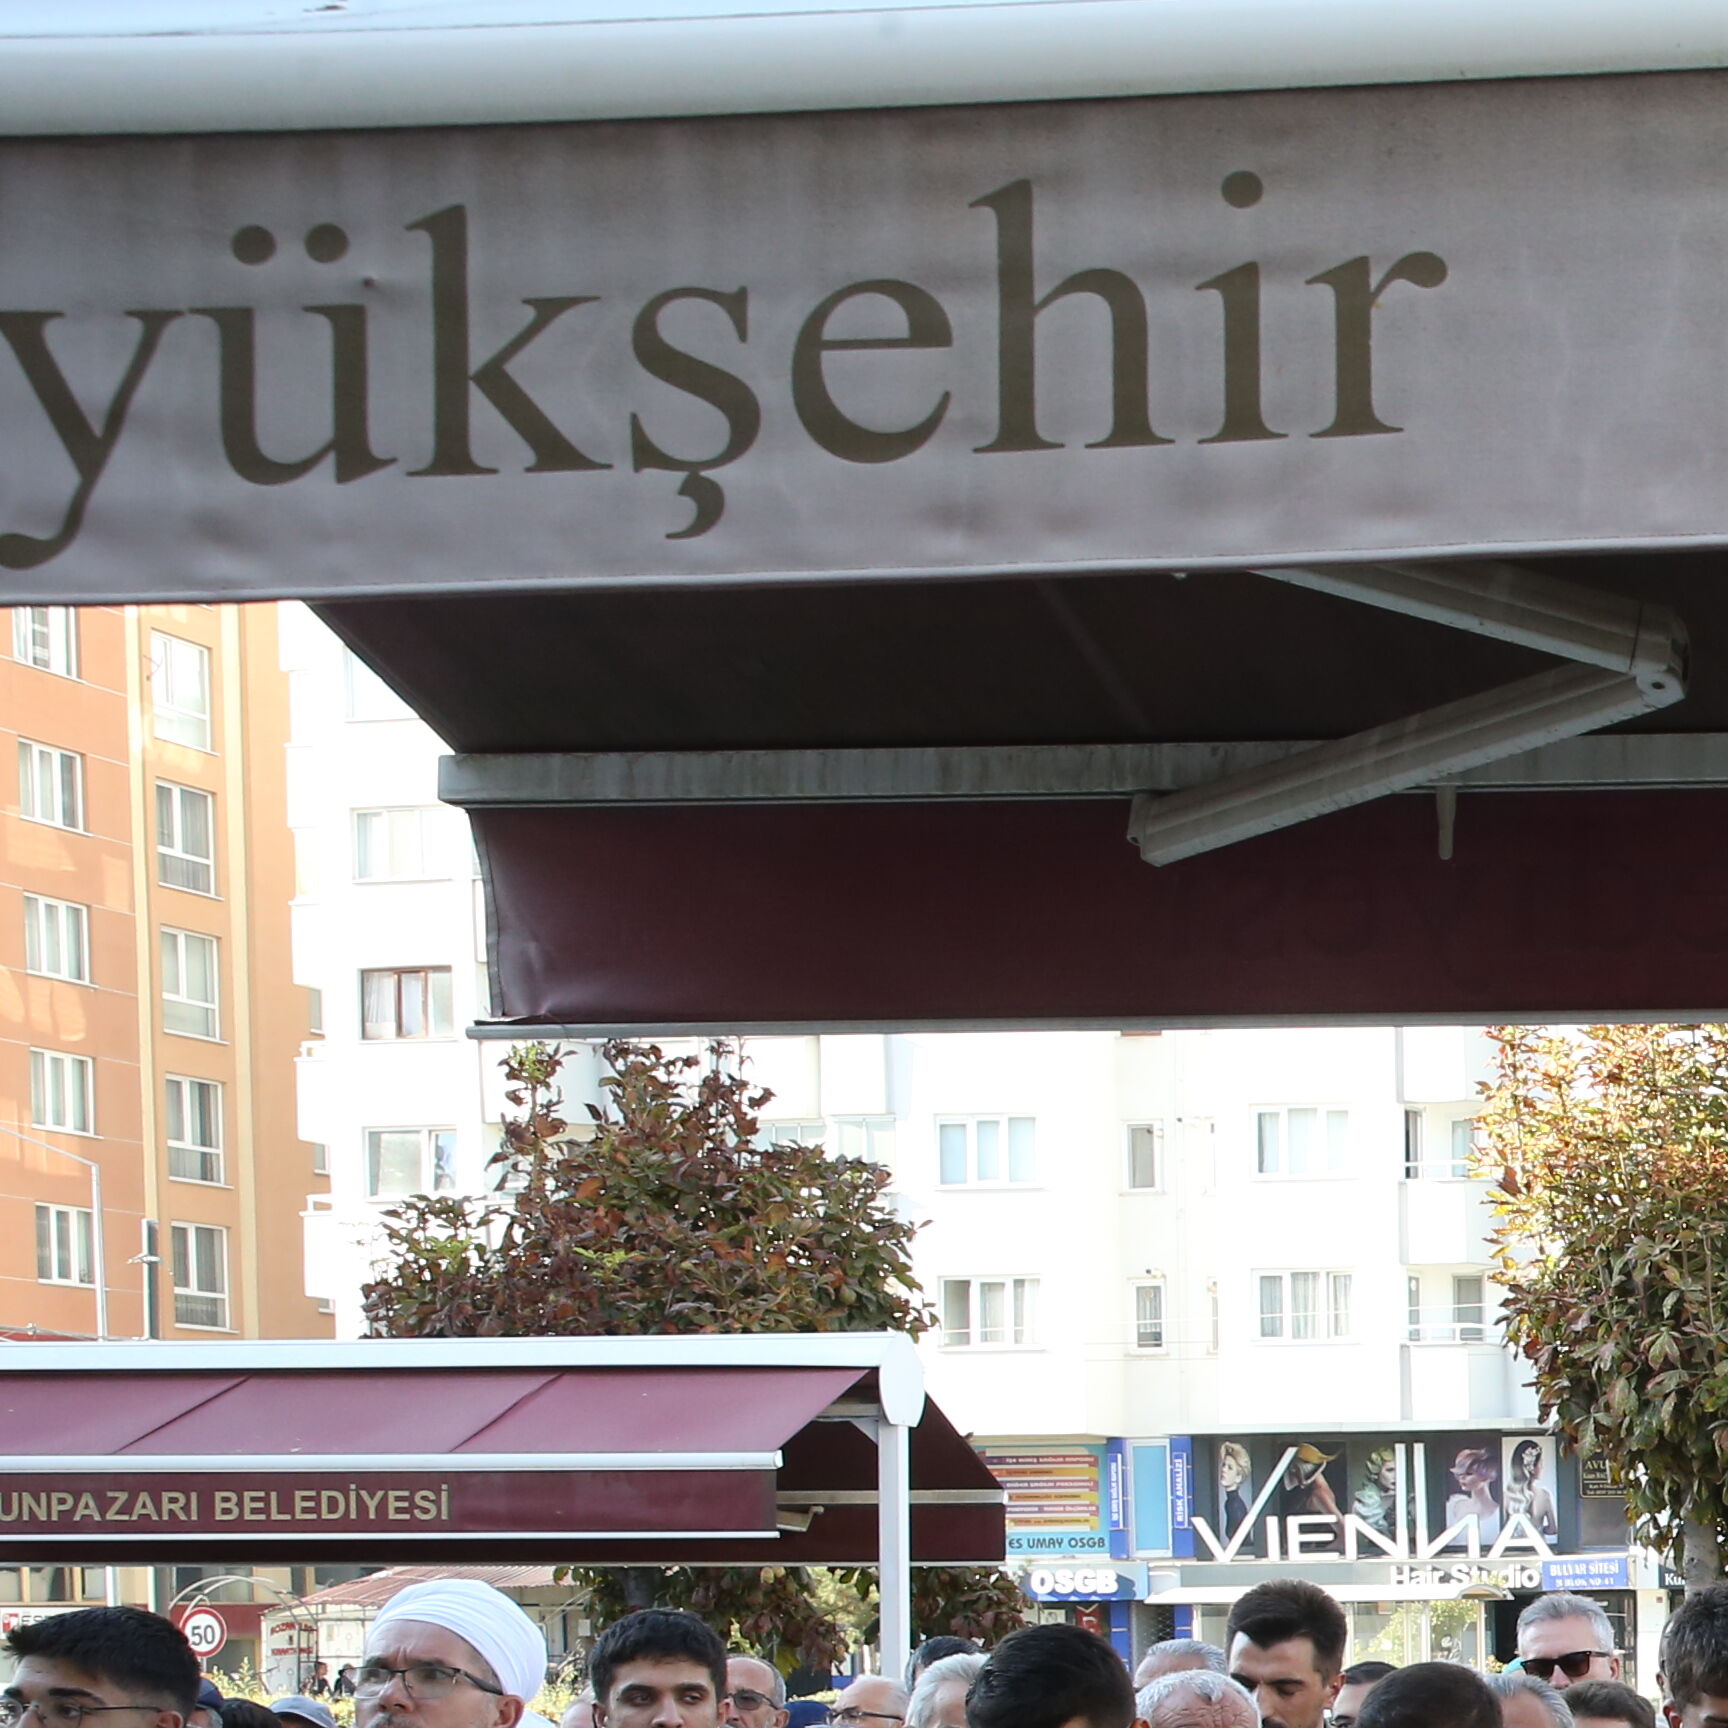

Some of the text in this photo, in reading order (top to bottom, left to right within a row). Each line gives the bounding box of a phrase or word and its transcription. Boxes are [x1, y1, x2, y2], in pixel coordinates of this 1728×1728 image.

[214, 1484, 449, 1521] BELEDİYESİ
[1191, 1443, 1556, 1562] VIENNA
[1027, 1536, 1063, 1549] UMAY
[1068, 1537, 1106, 1548] OSGB
[1031, 1568, 1119, 1594] OSGB
[1390, 1562, 1541, 1588] Hair Studio
[191, 1624, 215, 1646] 50
